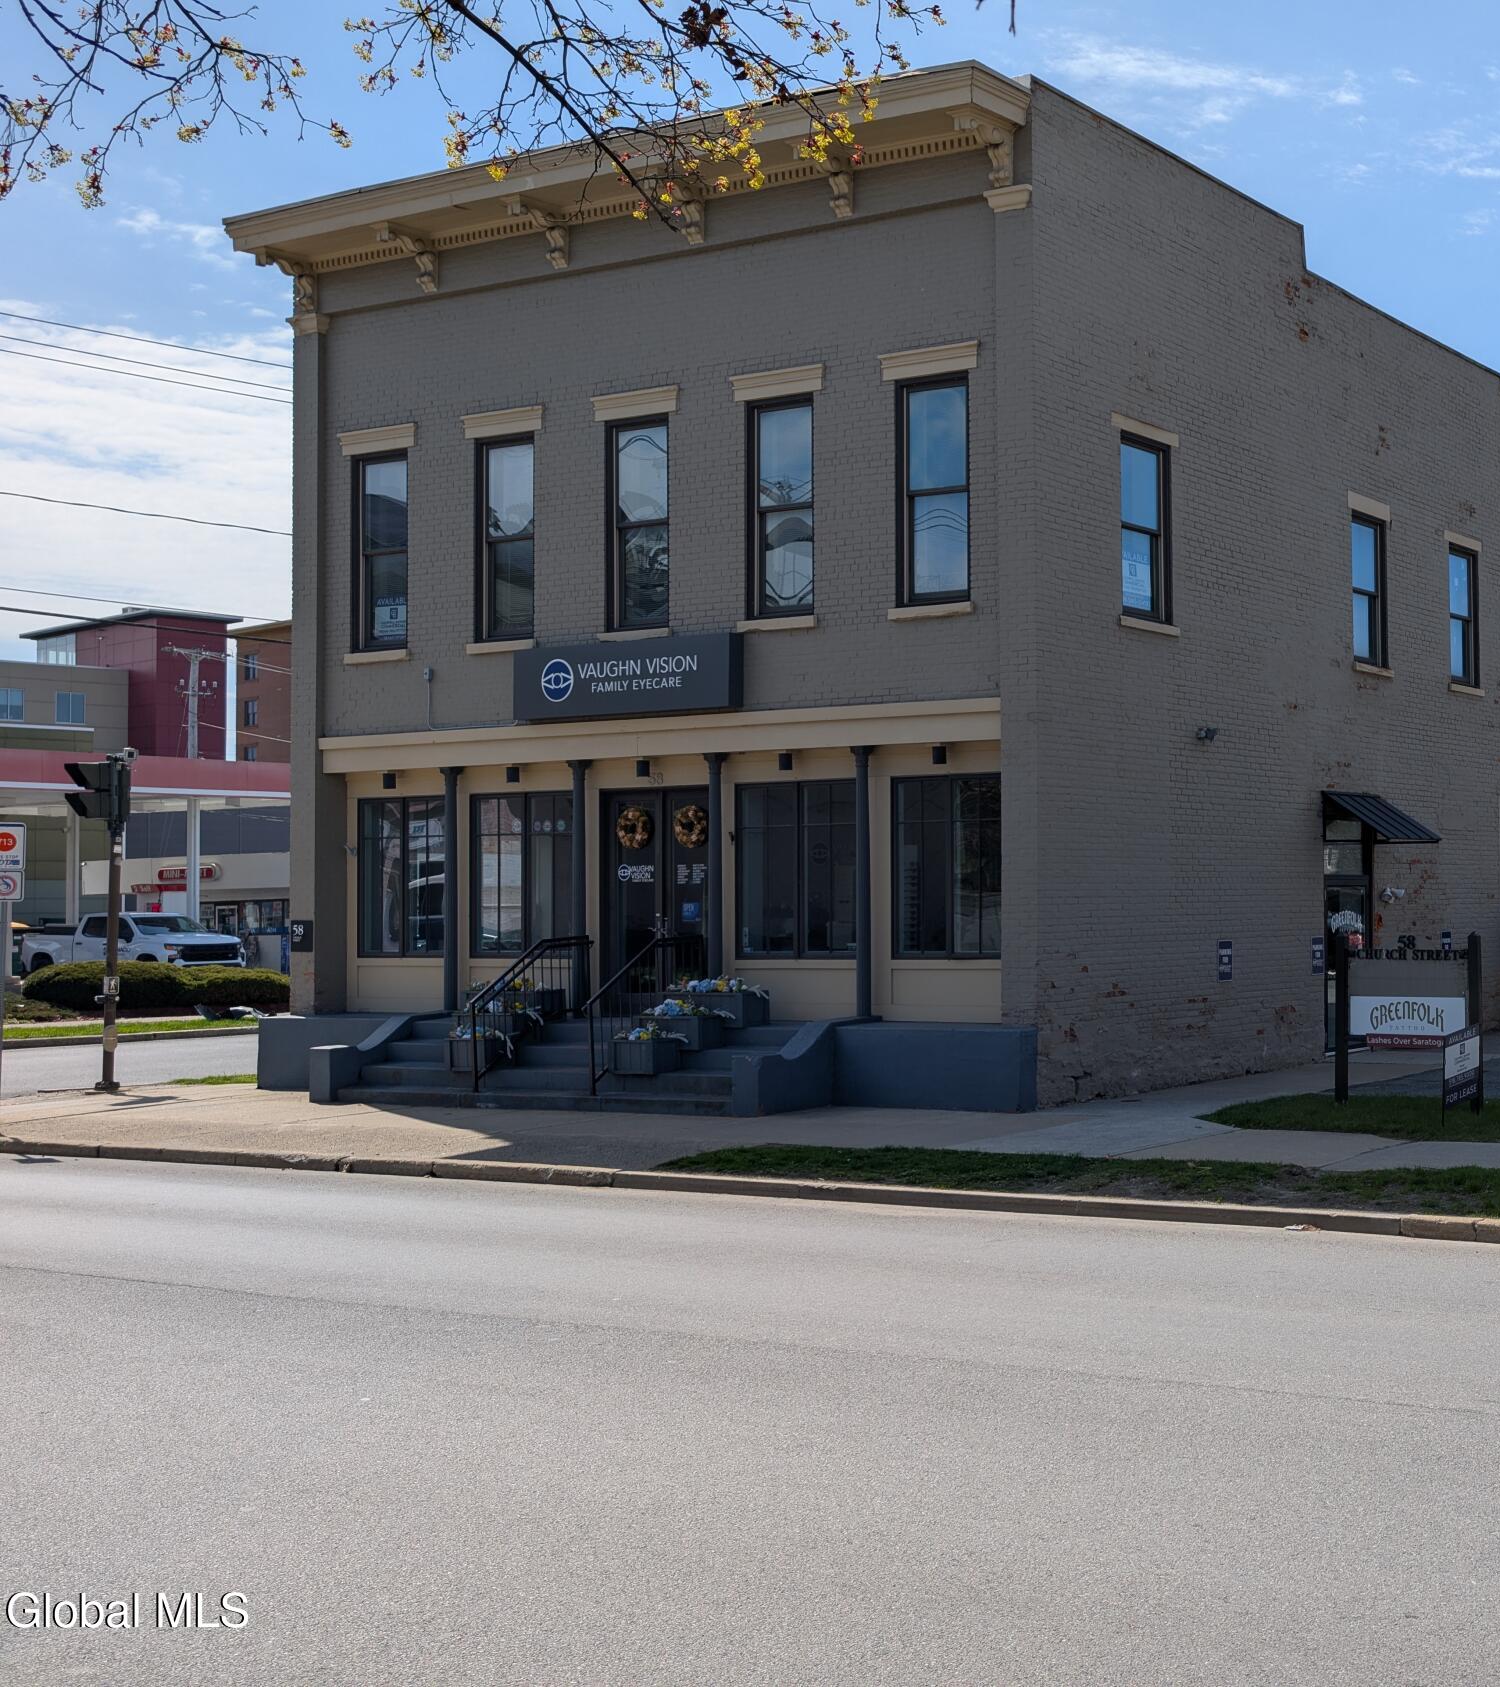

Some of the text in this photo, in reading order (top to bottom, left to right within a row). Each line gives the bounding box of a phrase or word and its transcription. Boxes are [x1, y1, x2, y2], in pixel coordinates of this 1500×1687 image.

[577, 654, 698, 680] VAUGHN VISION
[591, 676, 683, 693] FAMILY EYECARE
[629, 865, 655, 873] VAUGHN
[631, 872, 651, 880] VISION
[1331, 909, 1364, 934] GREENFOLK
[293, 924, 304, 936] 58
[1397, 934, 1416, 950] 58
[1356, 949, 1460, 961] CHURCH STREET
[1370, 1000, 1444, 1033] GREENFOLK
[1367, 1035, 1392, 1044] Lashes
[1393, 1037, 1411, 1045] Over
[1449, 1026, 1477, 1045] AVAILABLE
[1446, 1083, 1478, 1105] FOR LEASE
